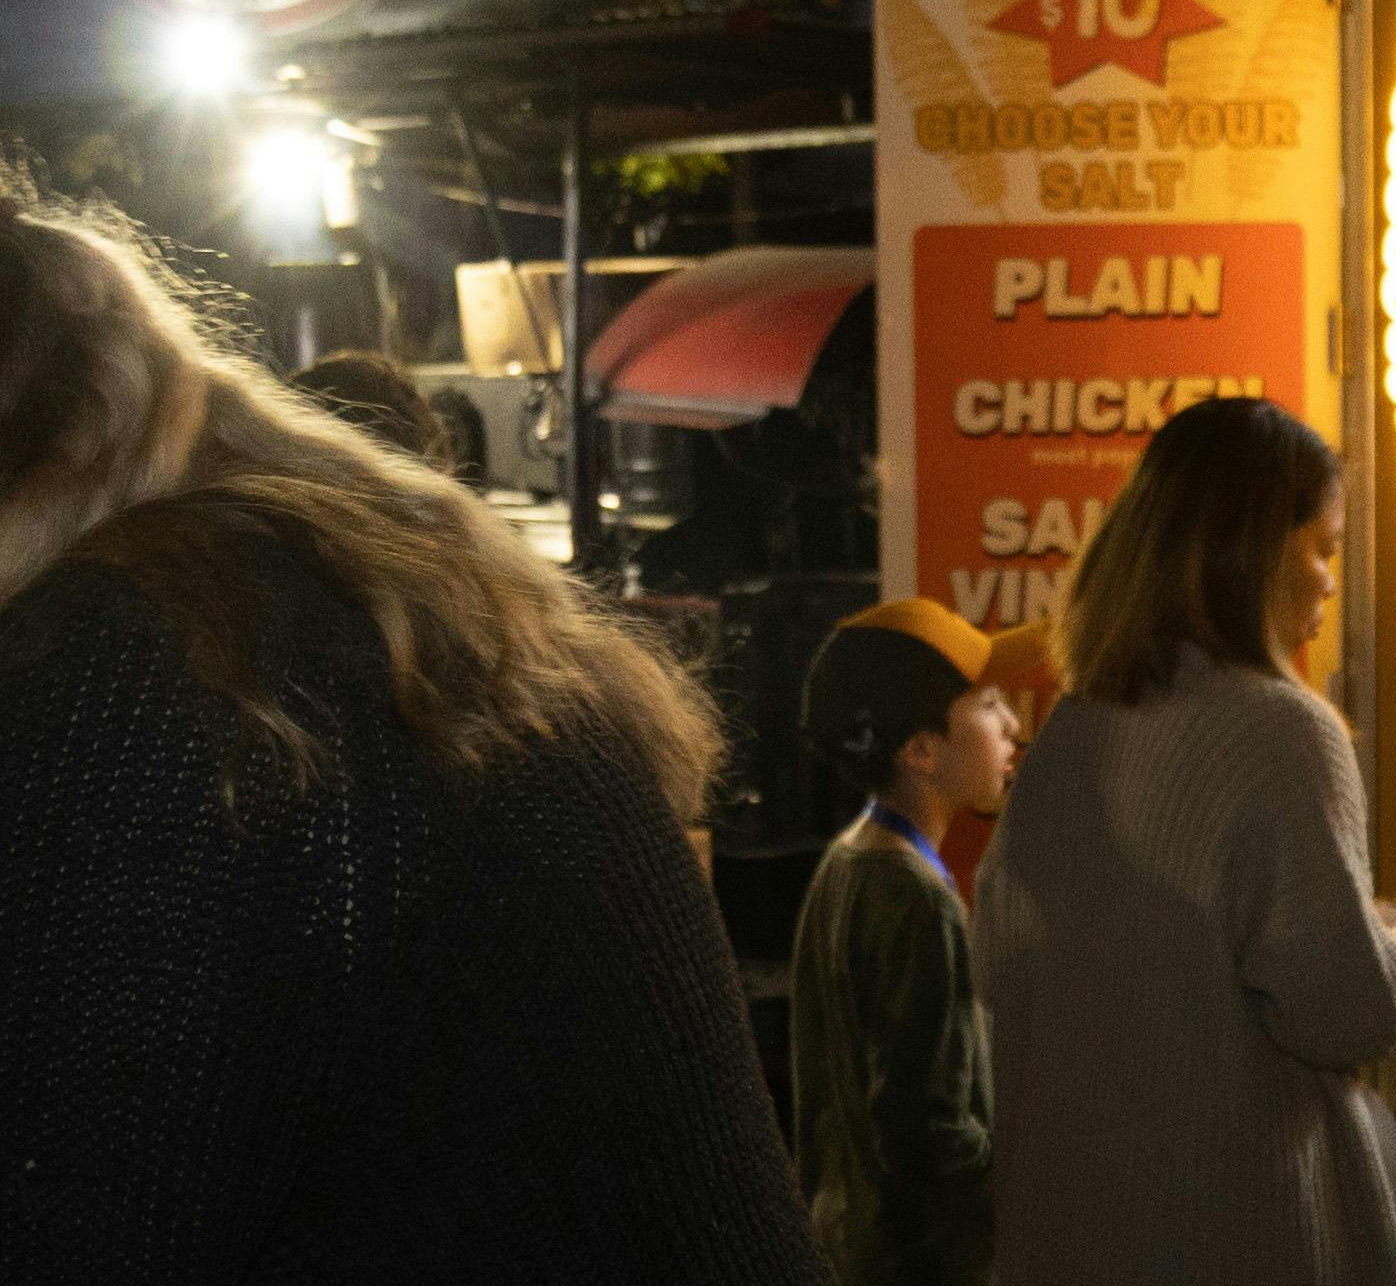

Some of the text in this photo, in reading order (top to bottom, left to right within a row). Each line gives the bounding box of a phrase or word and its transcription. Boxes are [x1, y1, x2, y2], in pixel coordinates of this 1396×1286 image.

[914, 95, 1301, 154] CHOOSE YOUR
[1038, 156, 1186, 212] SALT
[992, 254, 1225, 319] PLAIN
